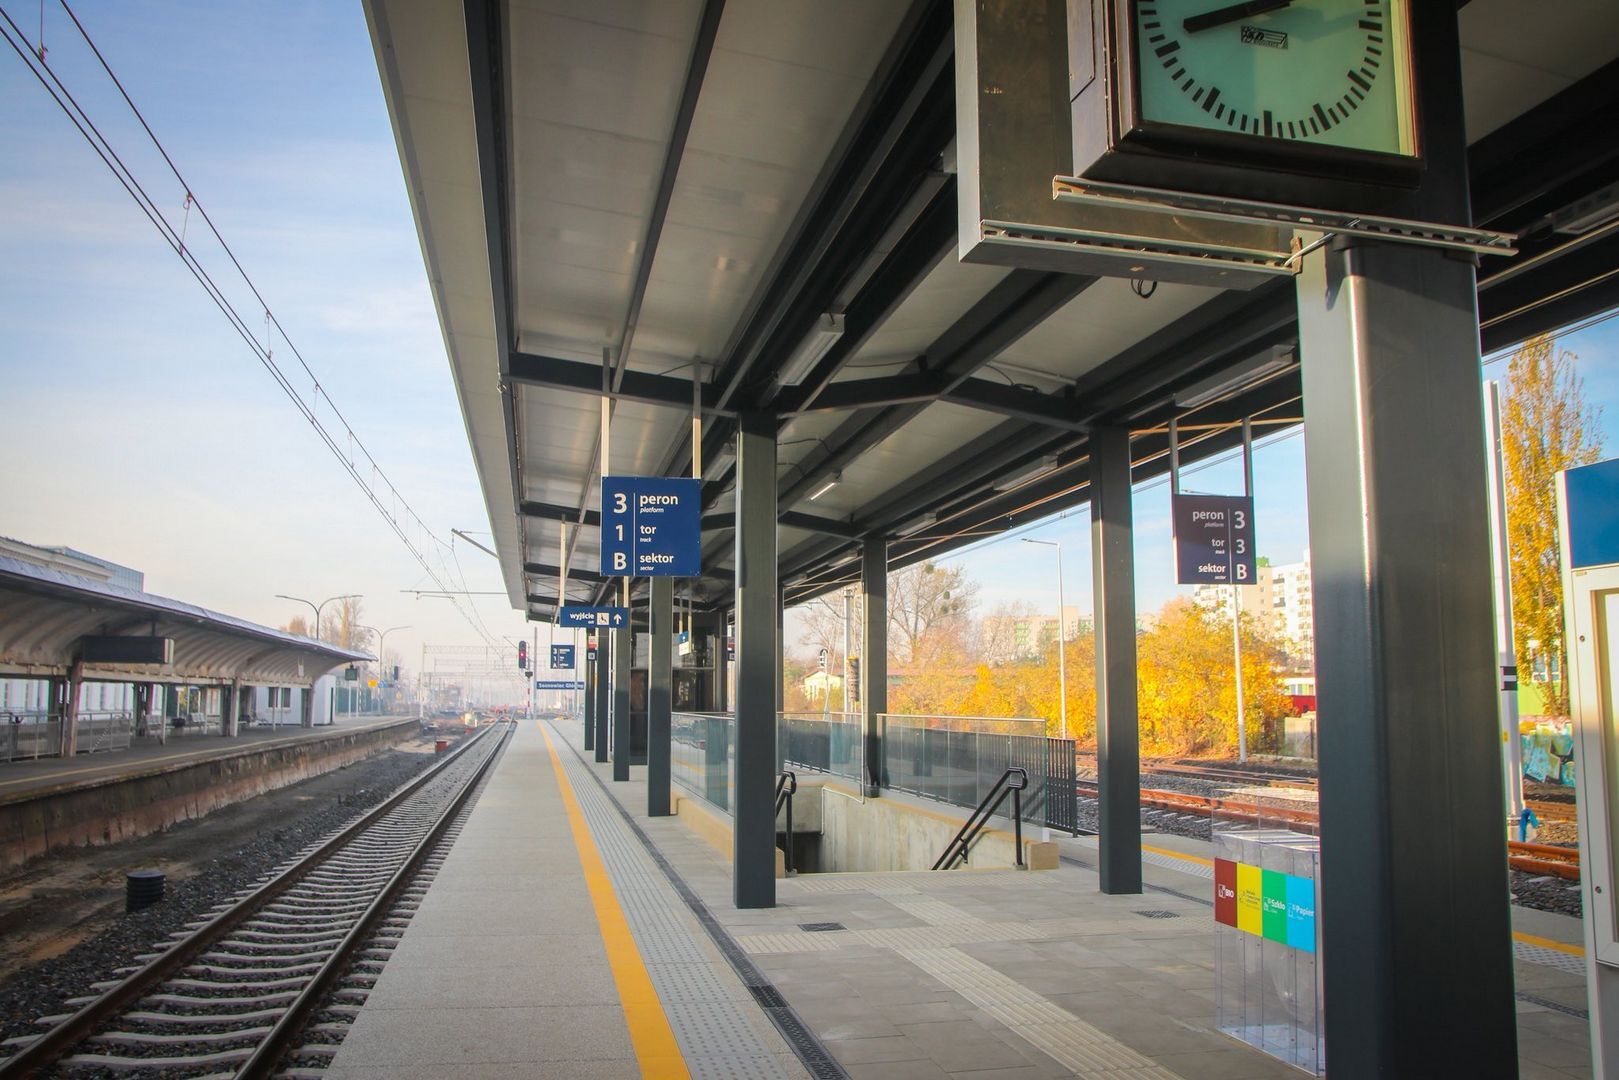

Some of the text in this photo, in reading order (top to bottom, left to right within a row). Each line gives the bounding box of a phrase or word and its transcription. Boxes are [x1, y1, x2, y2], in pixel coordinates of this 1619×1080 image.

[613, 493, 679, 514] 3 peron
[1192, 511, 1246, 529] peron 3
[615, 524, 657, 541] 1 tor
[1211, 538, 1246, 554] tor 3
[613, 552, 674, 570] B sektor
[1198, 563, 1247, 579] sektor B
[569, 612, 595, 621] wyjście
[1225, 888, 1235, 898] BIO
